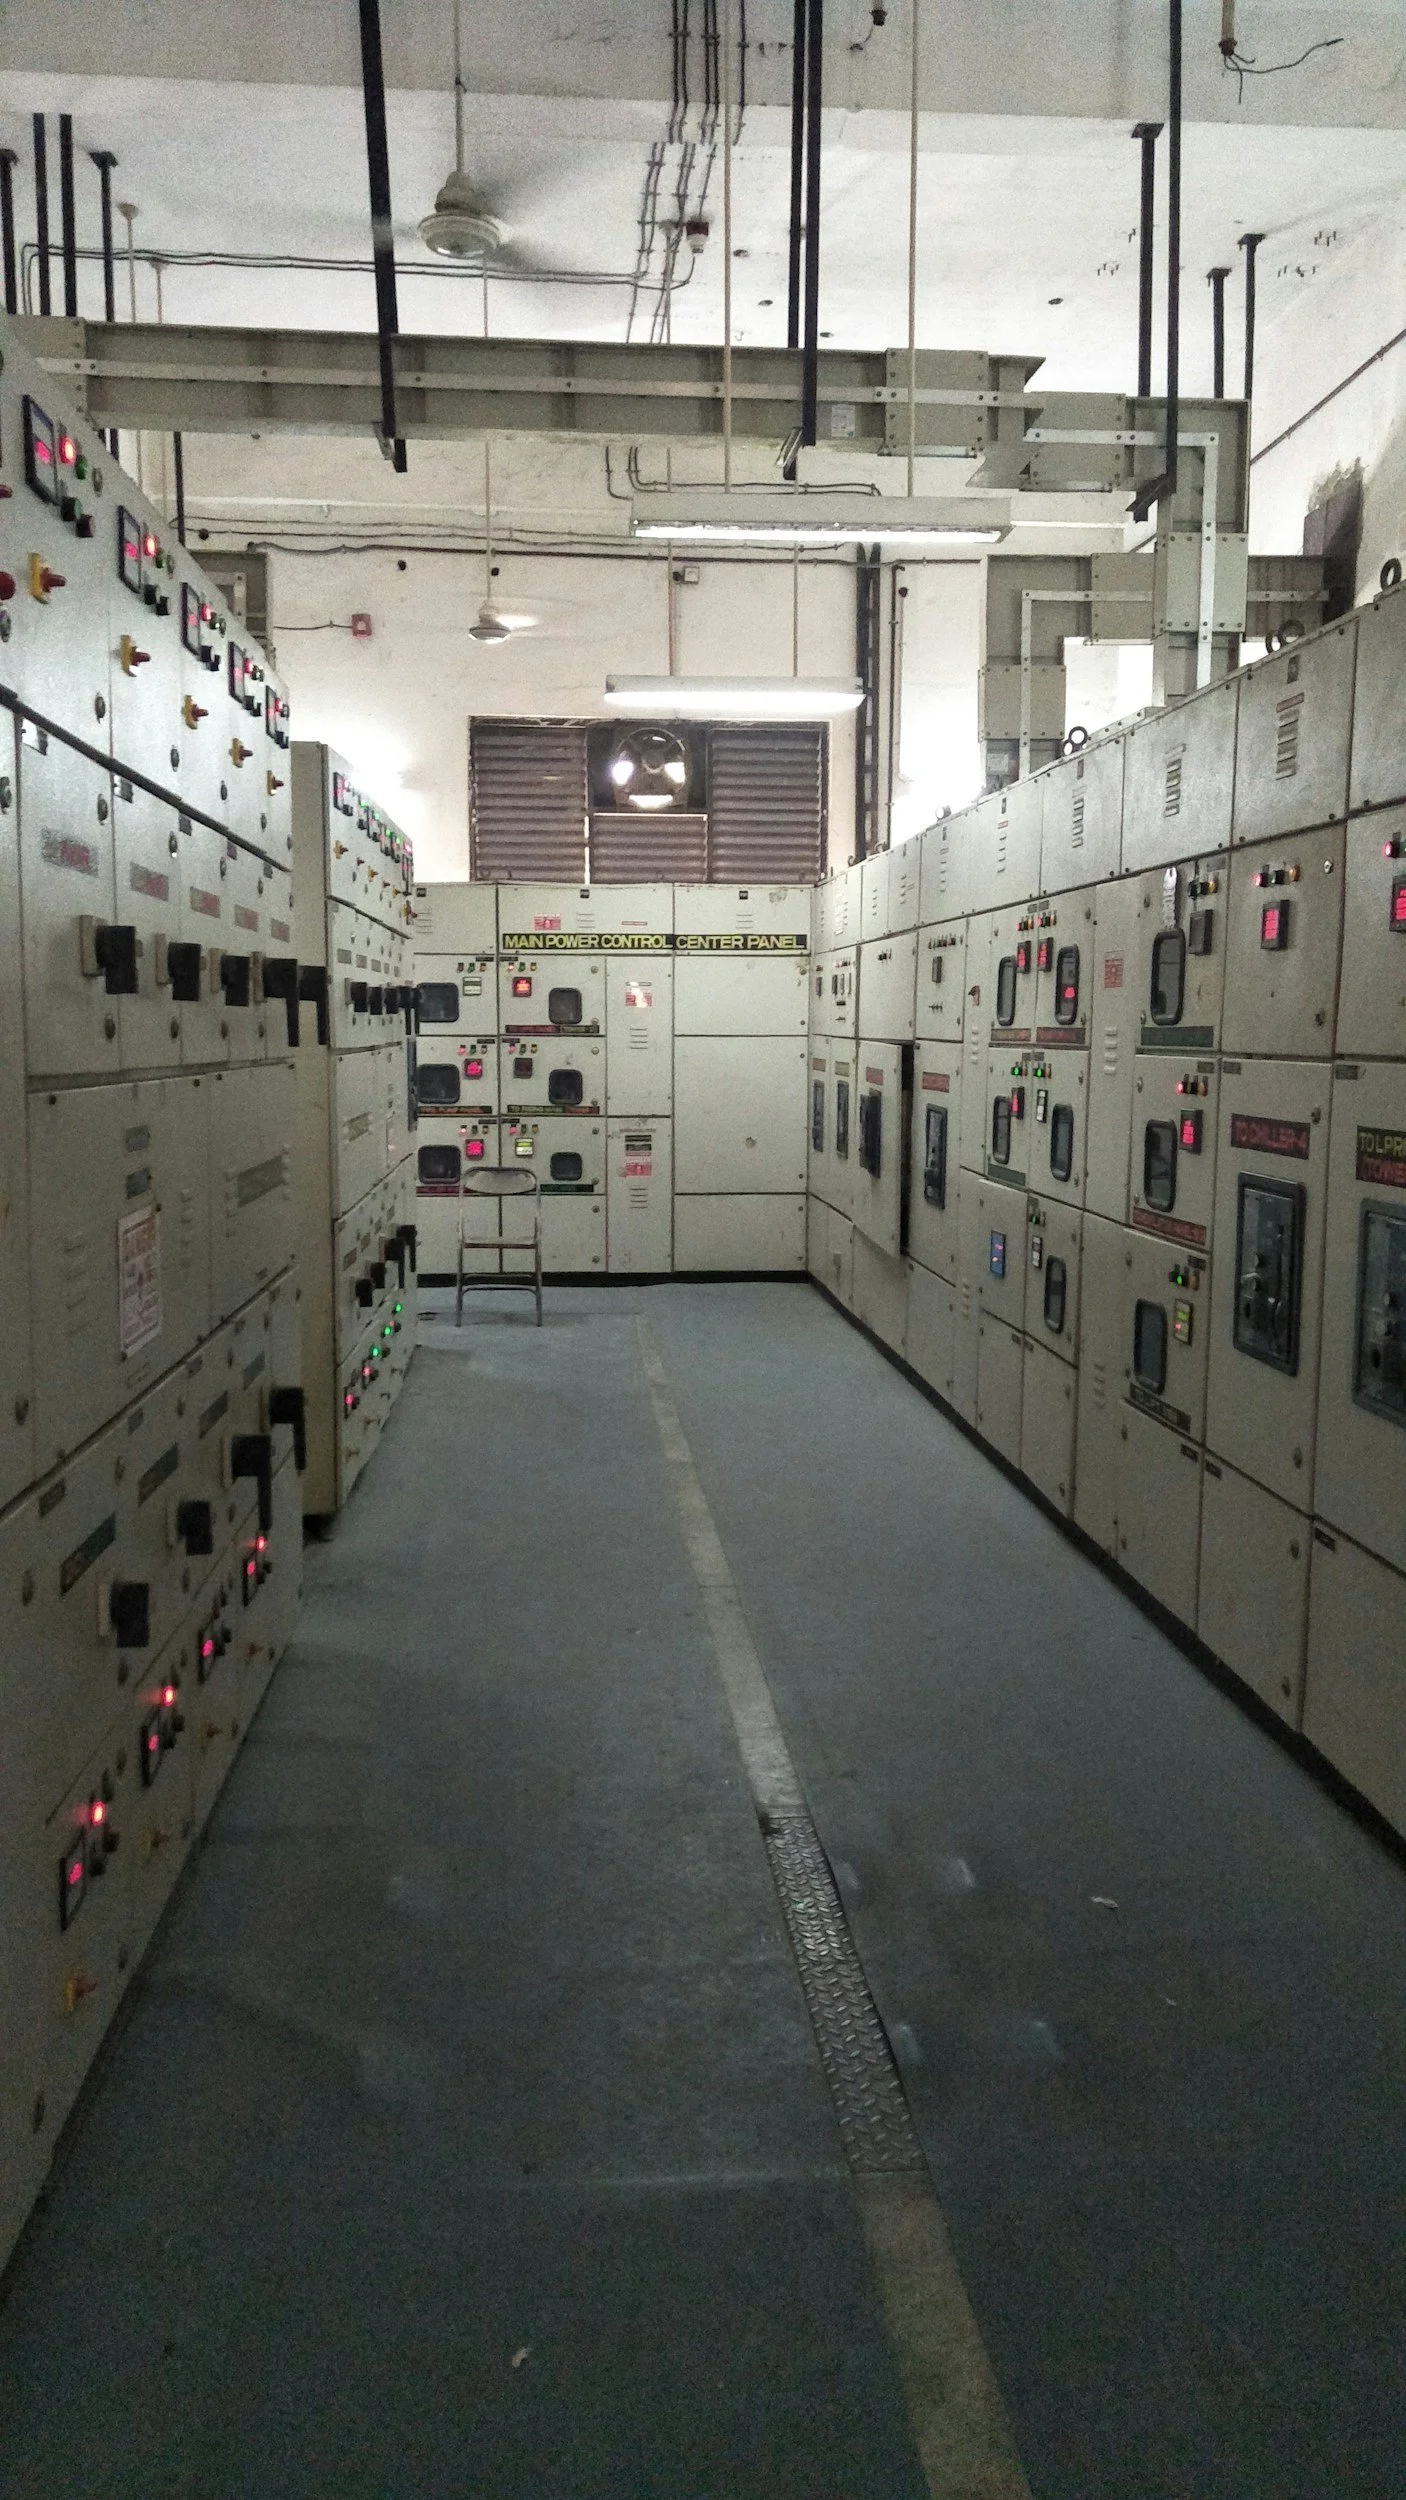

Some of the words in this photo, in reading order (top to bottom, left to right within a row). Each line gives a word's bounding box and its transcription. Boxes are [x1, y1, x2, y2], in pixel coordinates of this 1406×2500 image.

[505, 934, 543, 948] MAIN
[546, 934, 599, 948] POWER
[601, 935, 673, 949] CONTROL
[676, 935, 744, 949] CENTER
[747, 935, 804, 949] PANEL
[1358, 1131, 1374, 1152] TO
